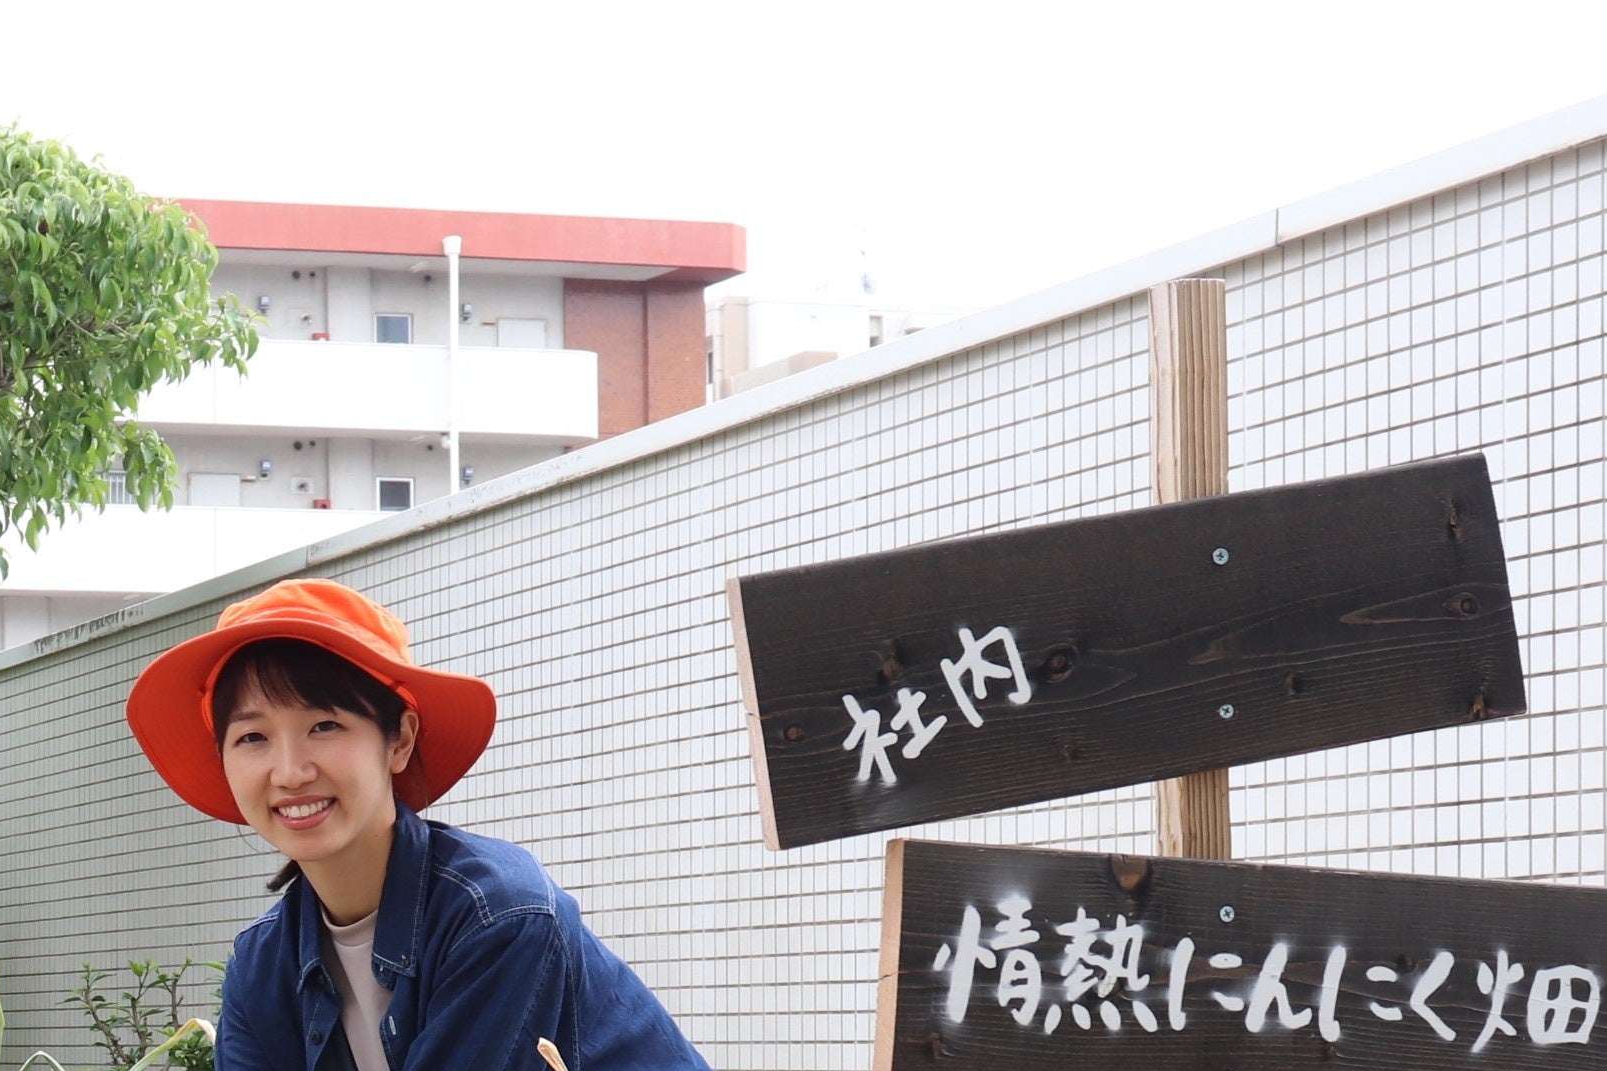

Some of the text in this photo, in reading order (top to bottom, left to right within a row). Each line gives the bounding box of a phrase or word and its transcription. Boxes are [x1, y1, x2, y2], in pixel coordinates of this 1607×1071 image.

[841, 625, 1033, 785] 社内
[934, 895, 1602, 1053] 情熱にんにく畑
